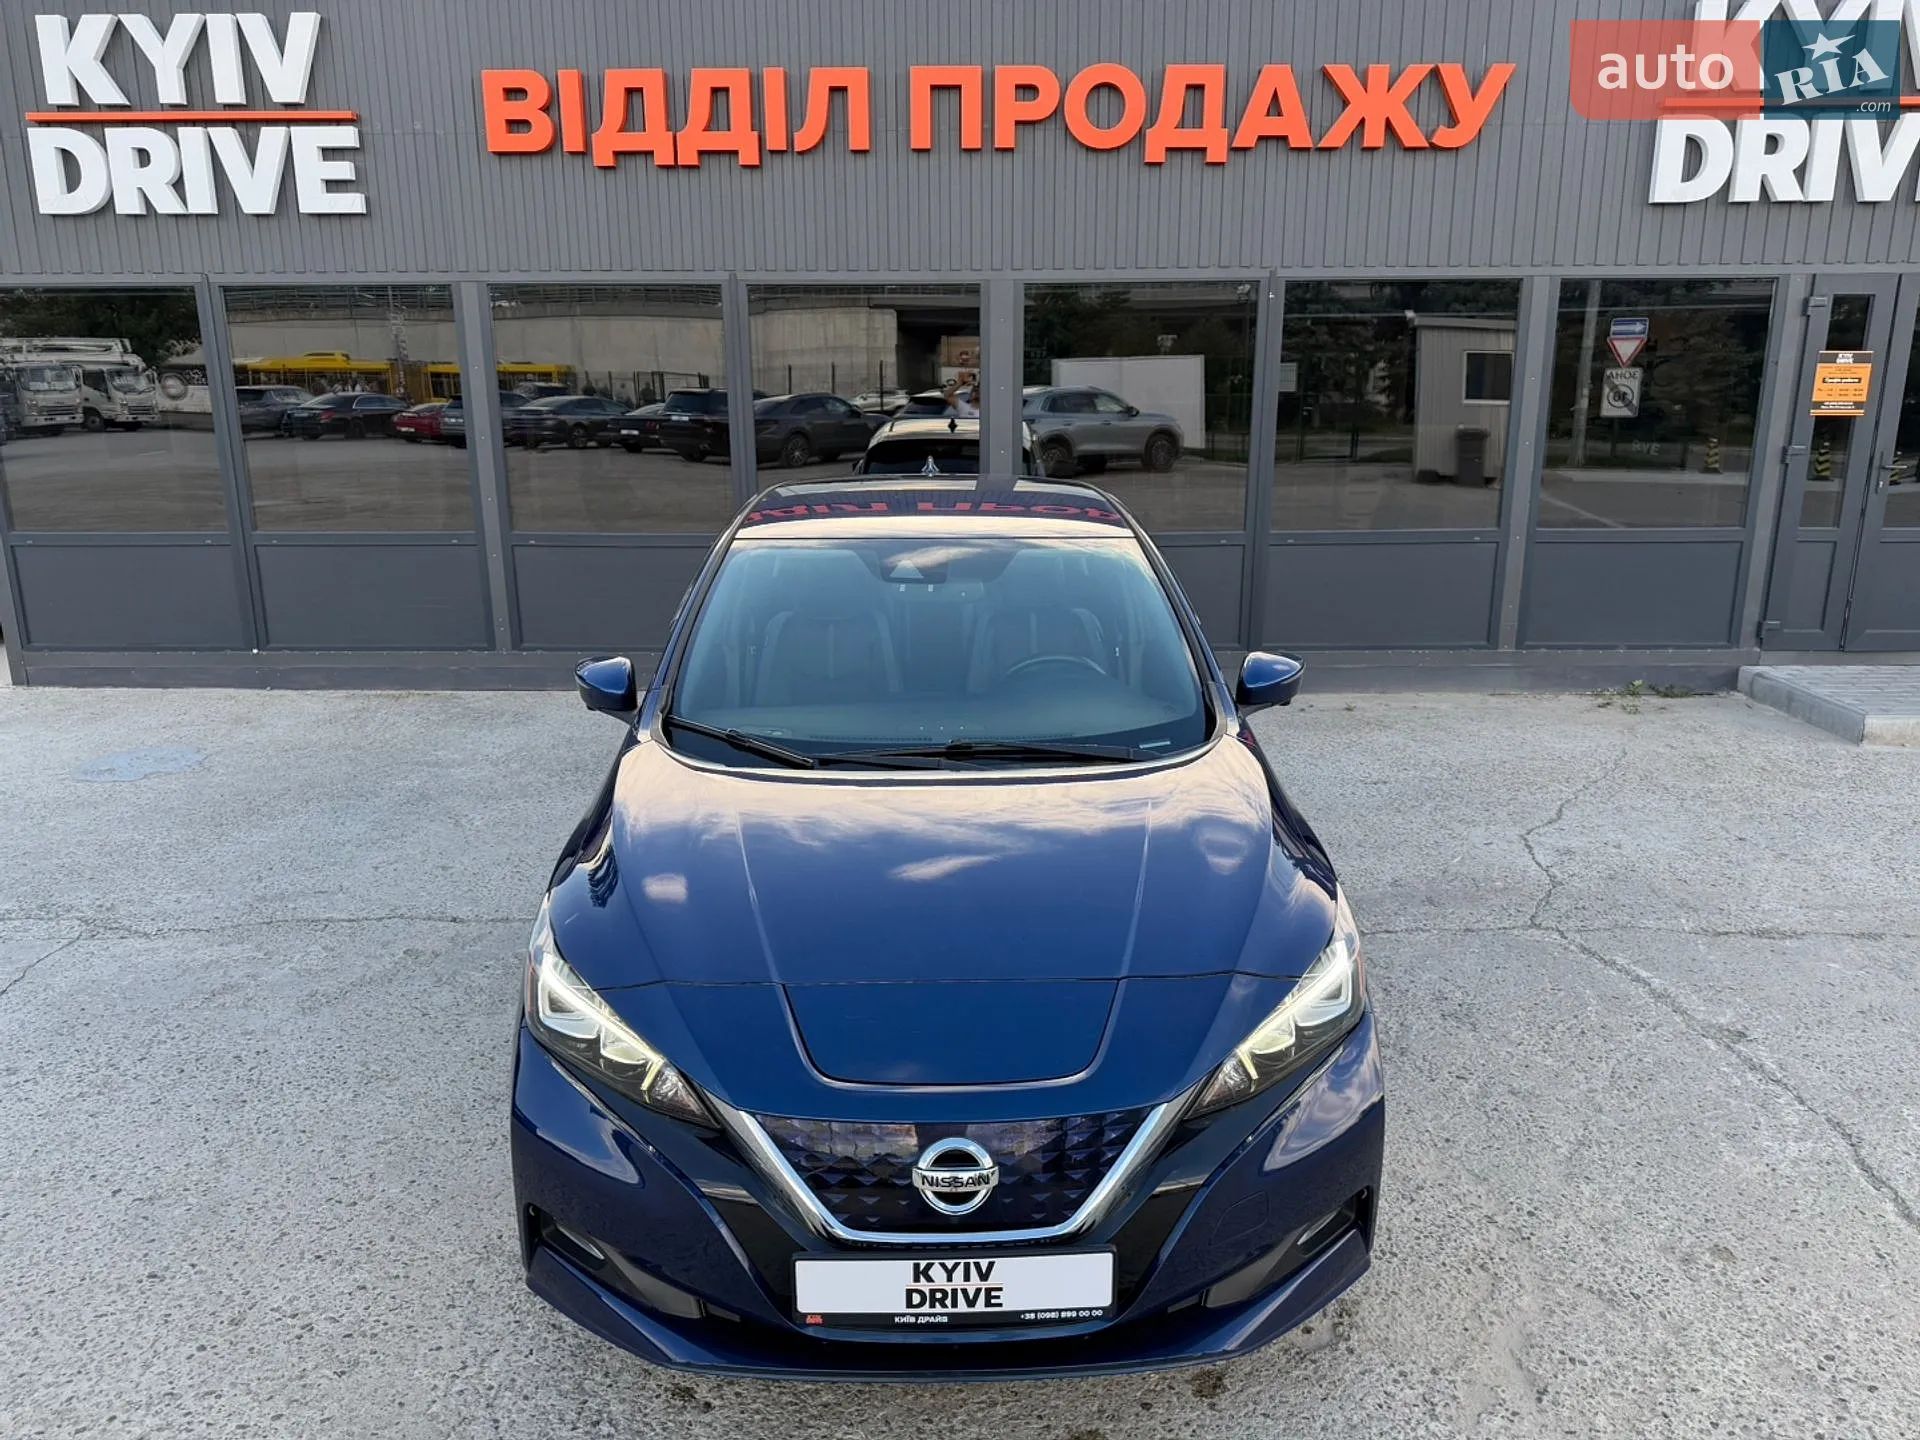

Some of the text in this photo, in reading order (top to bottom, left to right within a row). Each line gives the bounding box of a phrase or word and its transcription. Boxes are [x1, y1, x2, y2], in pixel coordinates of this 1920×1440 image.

[35, 12, 320, 106] KYIV
[1685, 0, 1920, 92] KYI
[481, 62, 1516, 167] ВІДДІЛ ПРОДАЖУ
[1648, 112, 1920, 203] DRIV
[27, 125, 367, 215] DRIVE
[921, 1173, 991, 1188] NISSAN
[905, 1287, 1003, 1309] DRIVE
[913, 1261, 996, 1283] KYIV
